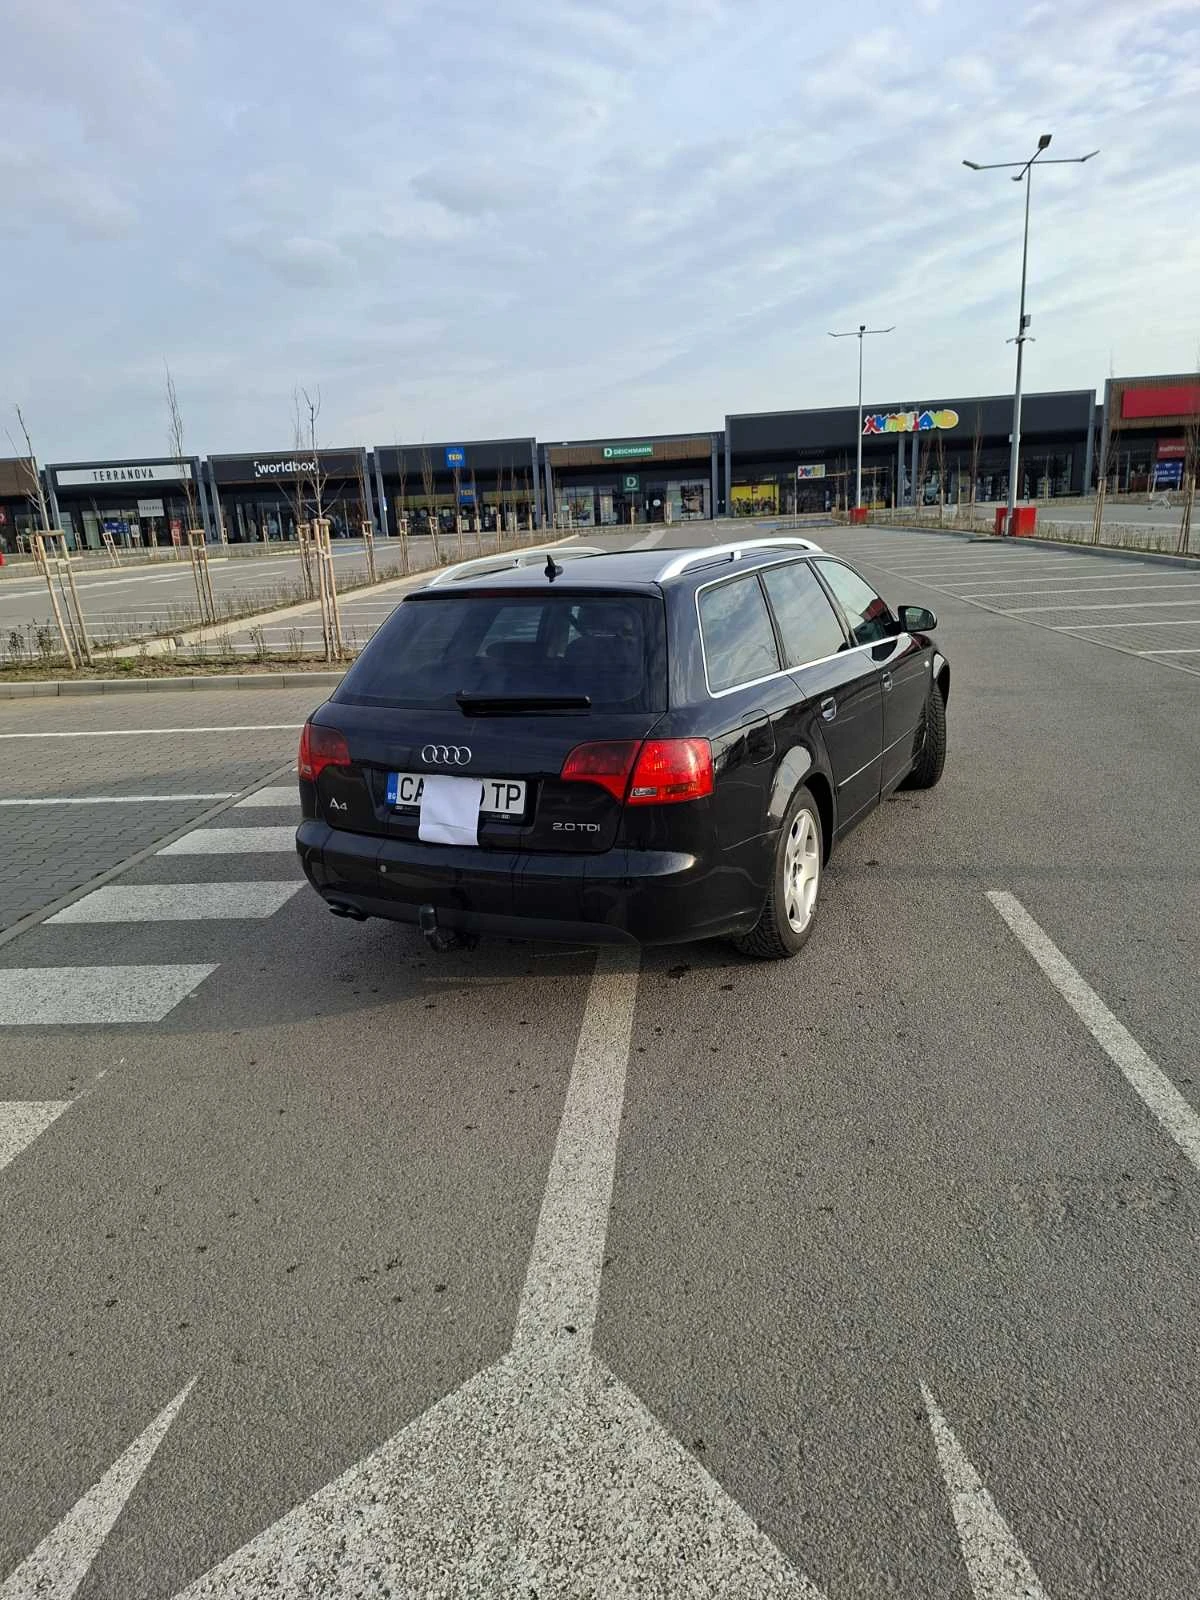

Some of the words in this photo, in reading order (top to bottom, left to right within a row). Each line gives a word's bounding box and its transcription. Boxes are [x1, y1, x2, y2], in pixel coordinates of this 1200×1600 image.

[257, 460, 316, 474] worldbox
[92, 468, 154, 481] TERRANOVA
[626, 476, 637, 488] D
[491, 782, 522, 810] TP
[329, 797, 348, 810] A4
